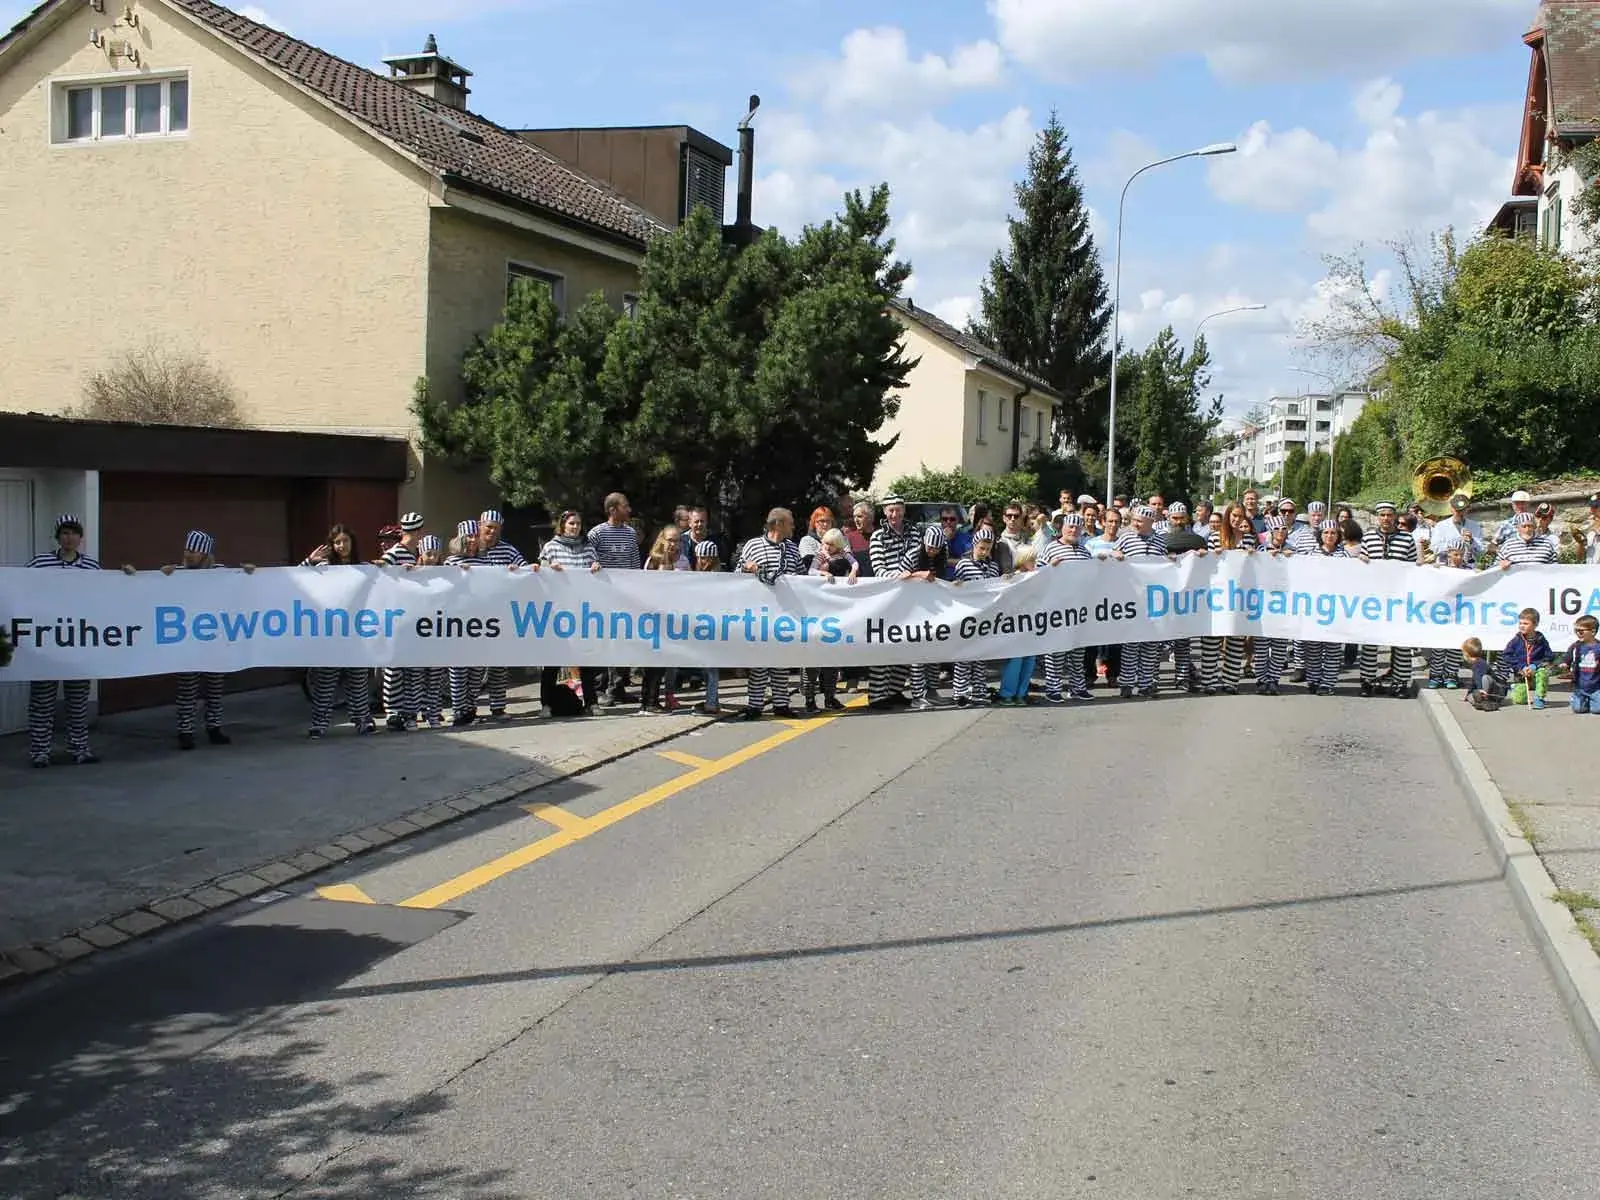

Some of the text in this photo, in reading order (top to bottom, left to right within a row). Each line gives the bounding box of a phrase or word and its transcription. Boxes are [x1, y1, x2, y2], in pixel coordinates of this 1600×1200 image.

[11, 579, 1519, 649] Früher Bewohner eines Wohnquartiers. Heute Gefangene des Durchgangverkehrs
